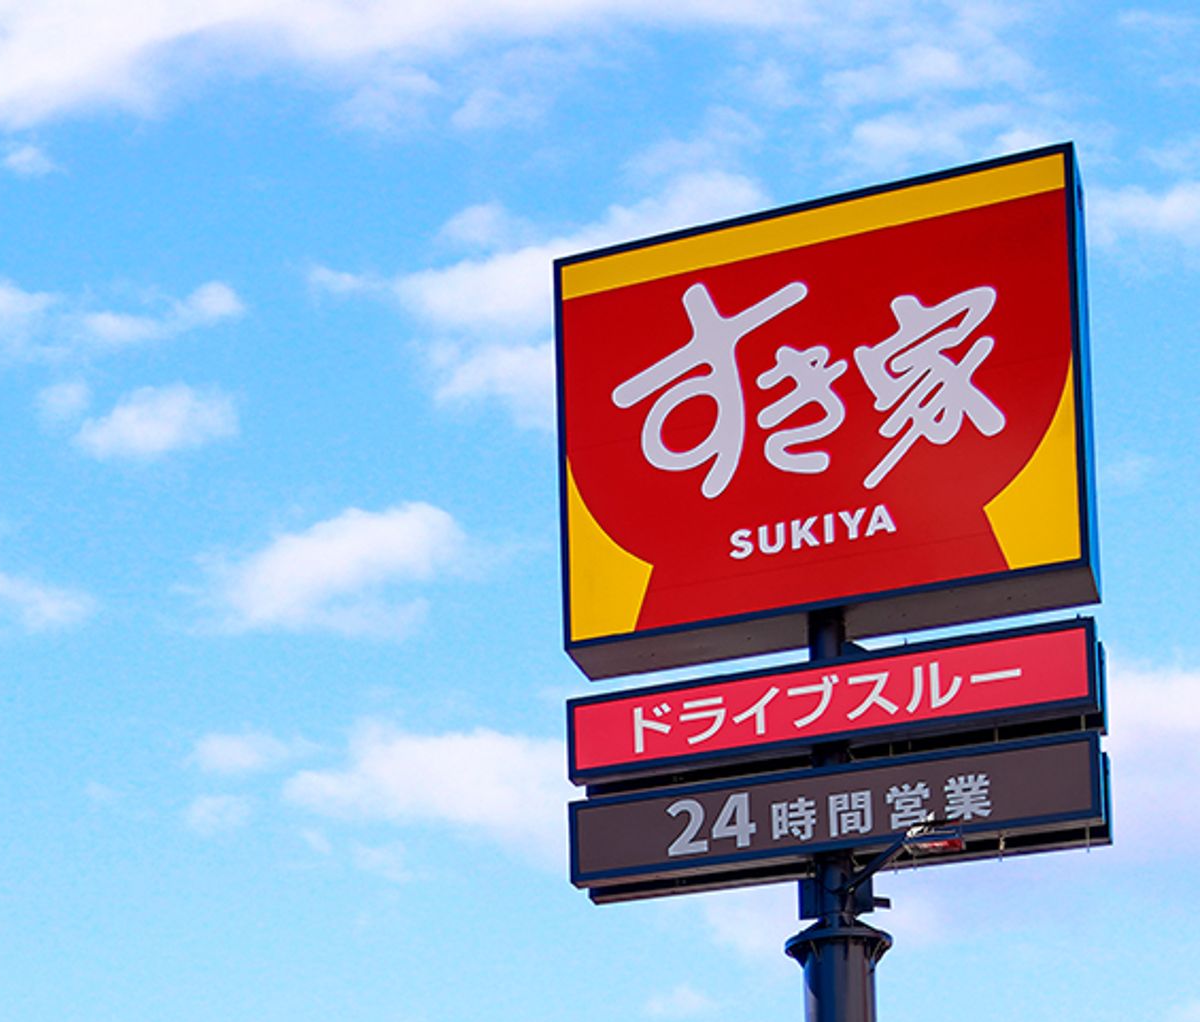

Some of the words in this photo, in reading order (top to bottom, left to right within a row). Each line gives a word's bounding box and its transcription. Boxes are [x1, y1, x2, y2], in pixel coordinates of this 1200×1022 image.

[612, 281, 1006, 499] すき家
[729, 503, 897, 560] SUKIYA
[633, 662, 1022, 754] ドライブスルー
[666, 774, 992, 857] 24時間営業
